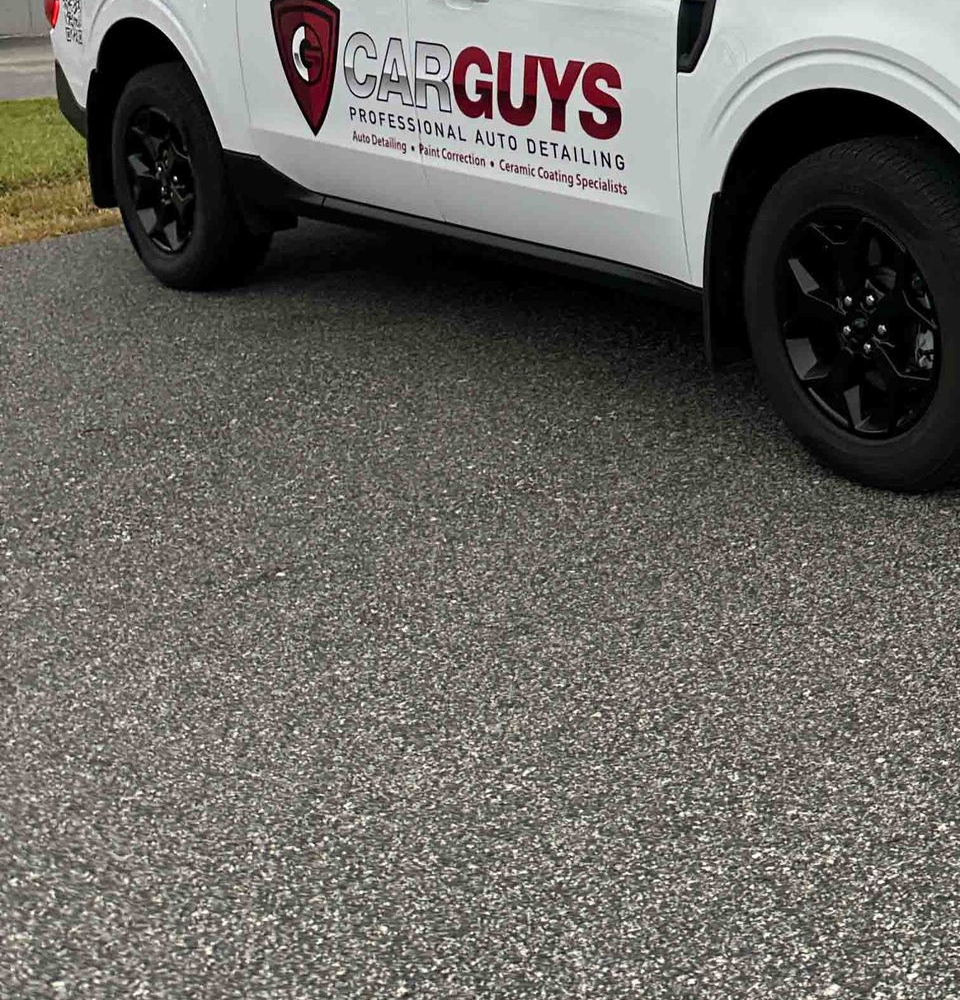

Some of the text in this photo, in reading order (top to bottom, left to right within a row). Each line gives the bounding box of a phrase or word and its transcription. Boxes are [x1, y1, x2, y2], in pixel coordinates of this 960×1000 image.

[349, 106, 625, 170] PROFESSIONAL AUTO DETAILING
[352, 130, 628, 195] Auto Detailing Paint Correction Ceramic Coating Specialists
